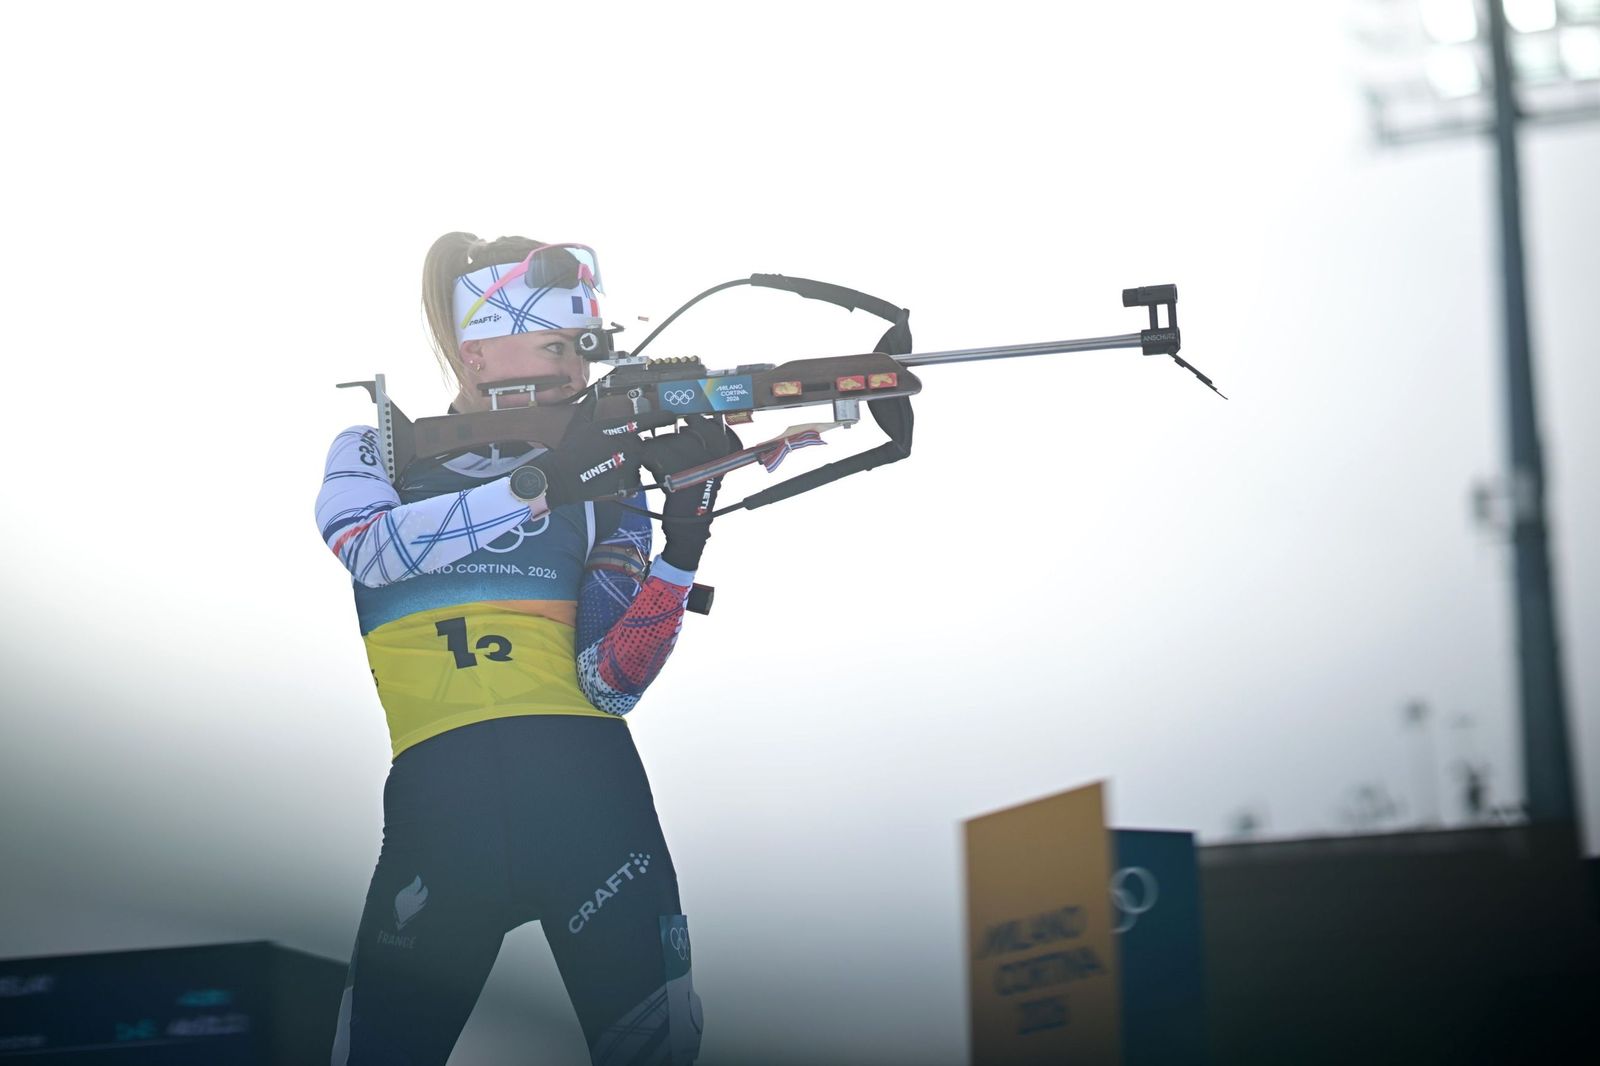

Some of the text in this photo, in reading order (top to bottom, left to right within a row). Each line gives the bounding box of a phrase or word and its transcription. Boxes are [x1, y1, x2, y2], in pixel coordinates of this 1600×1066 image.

[716, 383, 743, 391] MILANO
[720, 389, 749, 397] CORTINA
[602, 421, 638, 436] KINETIX
[580, 452, 626, 483] KINETIX
[456, 563, 524, 575] CORTINA
[527, 565, 557, 580] 2026
[568, 862, 635, 934] CRAFT
[377, 930, 417, 949] FRANCE
